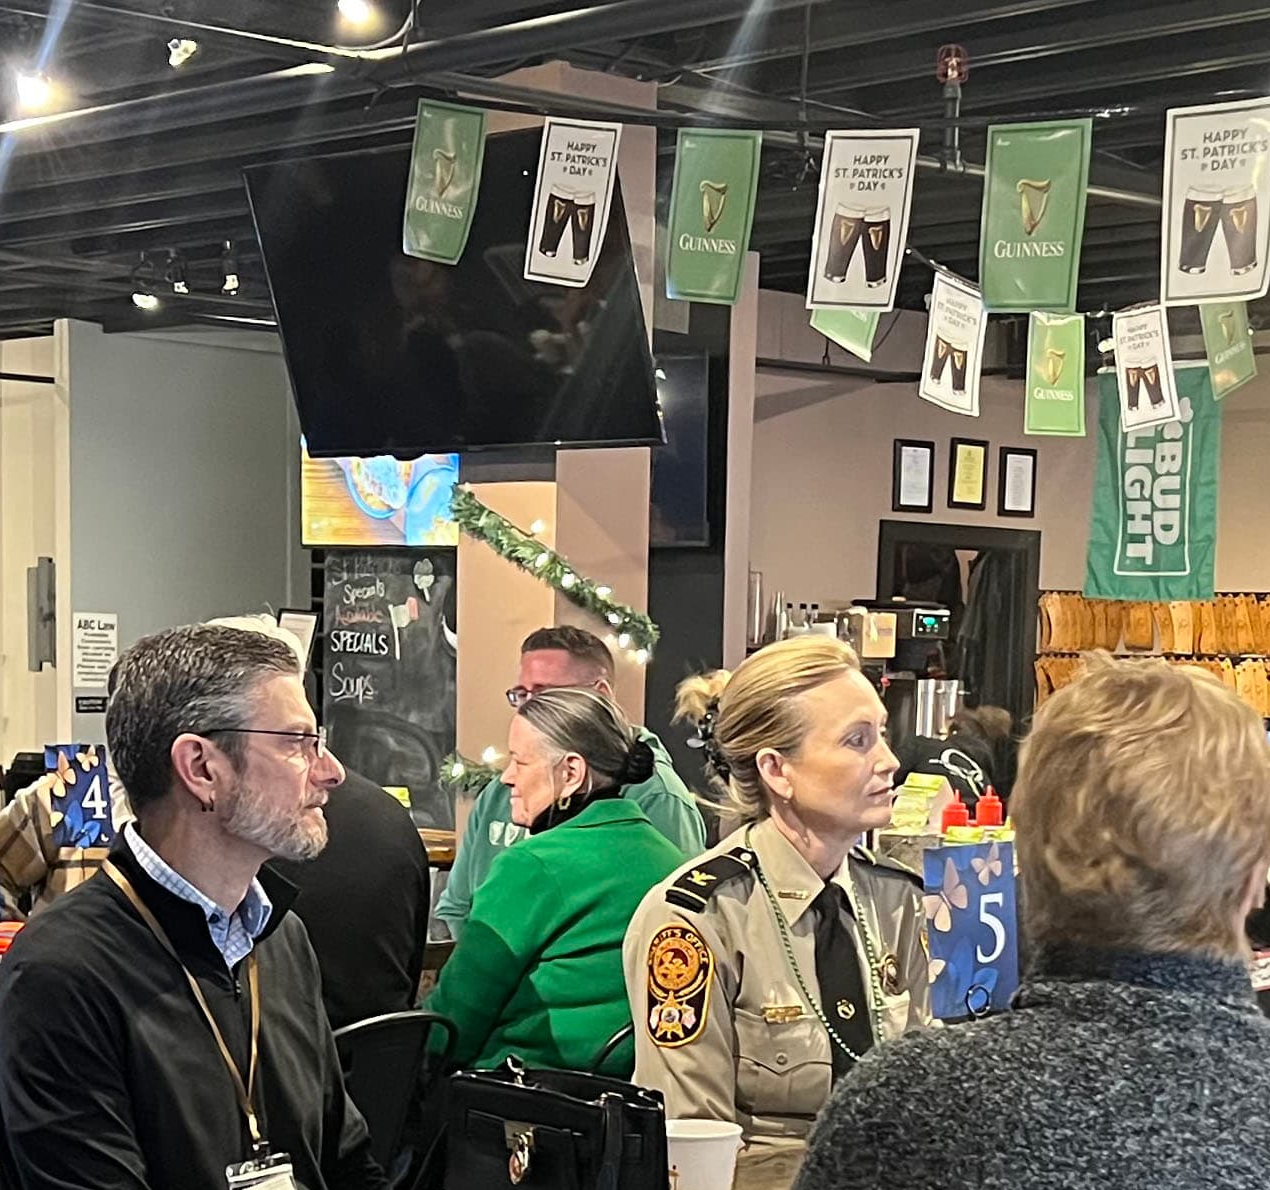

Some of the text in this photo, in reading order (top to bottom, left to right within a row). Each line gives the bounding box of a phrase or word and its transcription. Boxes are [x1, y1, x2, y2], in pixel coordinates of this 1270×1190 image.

[1203, 128, 1249, 144] HAPPY
[567, 141, 597, 153] HAPPY
[1180, 140, 1268, 160] ST. PATRICK'S
[550, 152, 608, 167] ST. PATRICK'S
[853, 155, 890, 166] HAPPY
[1211, 158, 1238, 172] DAY
[569, 165, 587, 177] DAY
[834, 168, 904, 179] ST. PATRICK'S
[857, 181, 879, 192] DAY
[415, 196, 463, 219] GUINNESS
[679, 233, 736, 254] GUINNESS
[993, 239, 1065, 258] GUINNESS
[1124, 426, 1156, 566] LIGHT
[1152, 440, 1183, 546] BUD
[82, 774, 108, 820] 4
[976, 892, 1005, 964] 5
